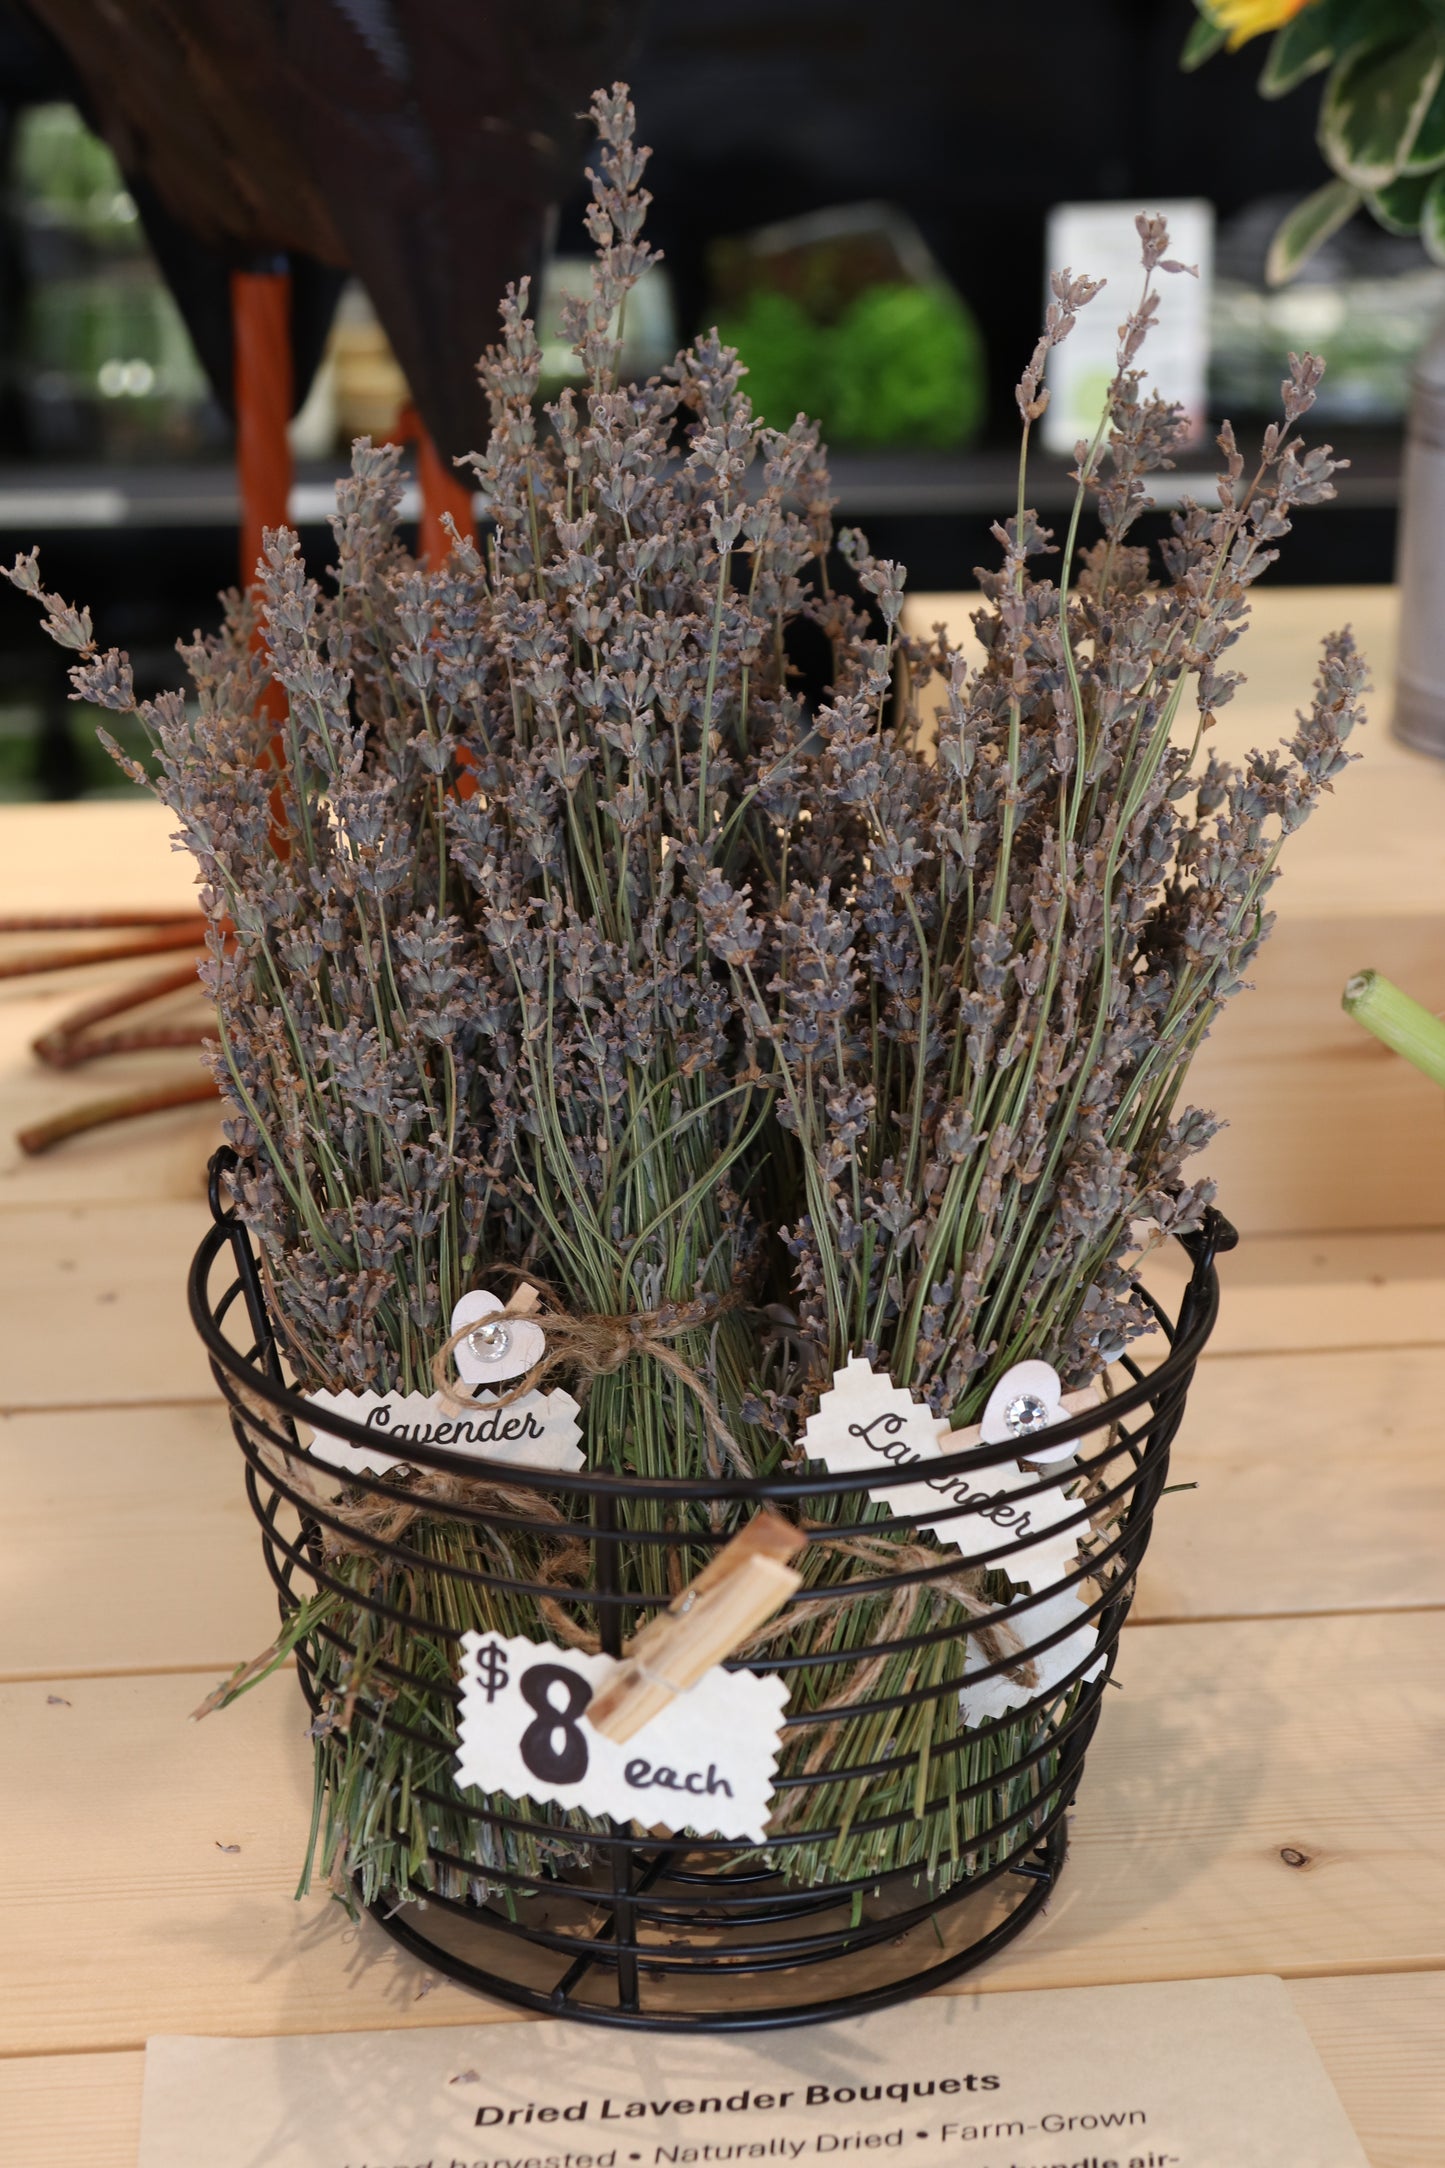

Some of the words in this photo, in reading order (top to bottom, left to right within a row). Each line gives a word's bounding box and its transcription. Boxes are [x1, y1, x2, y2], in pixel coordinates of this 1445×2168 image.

[848, 1412, 1035, 1540] Laender
[624, 1758, 735, 1799] each
[474, 2101, 588, 2127] Dried
[600, 2089, 795, 2121] Lavender
[805, 2072, 1001, 2106] Bouquets
[654, 2137, 806, 2164] Naturally
[815, 2128, 904, 2153] Dried
[941, 2108, 1147, 2142] Farm-Grown
